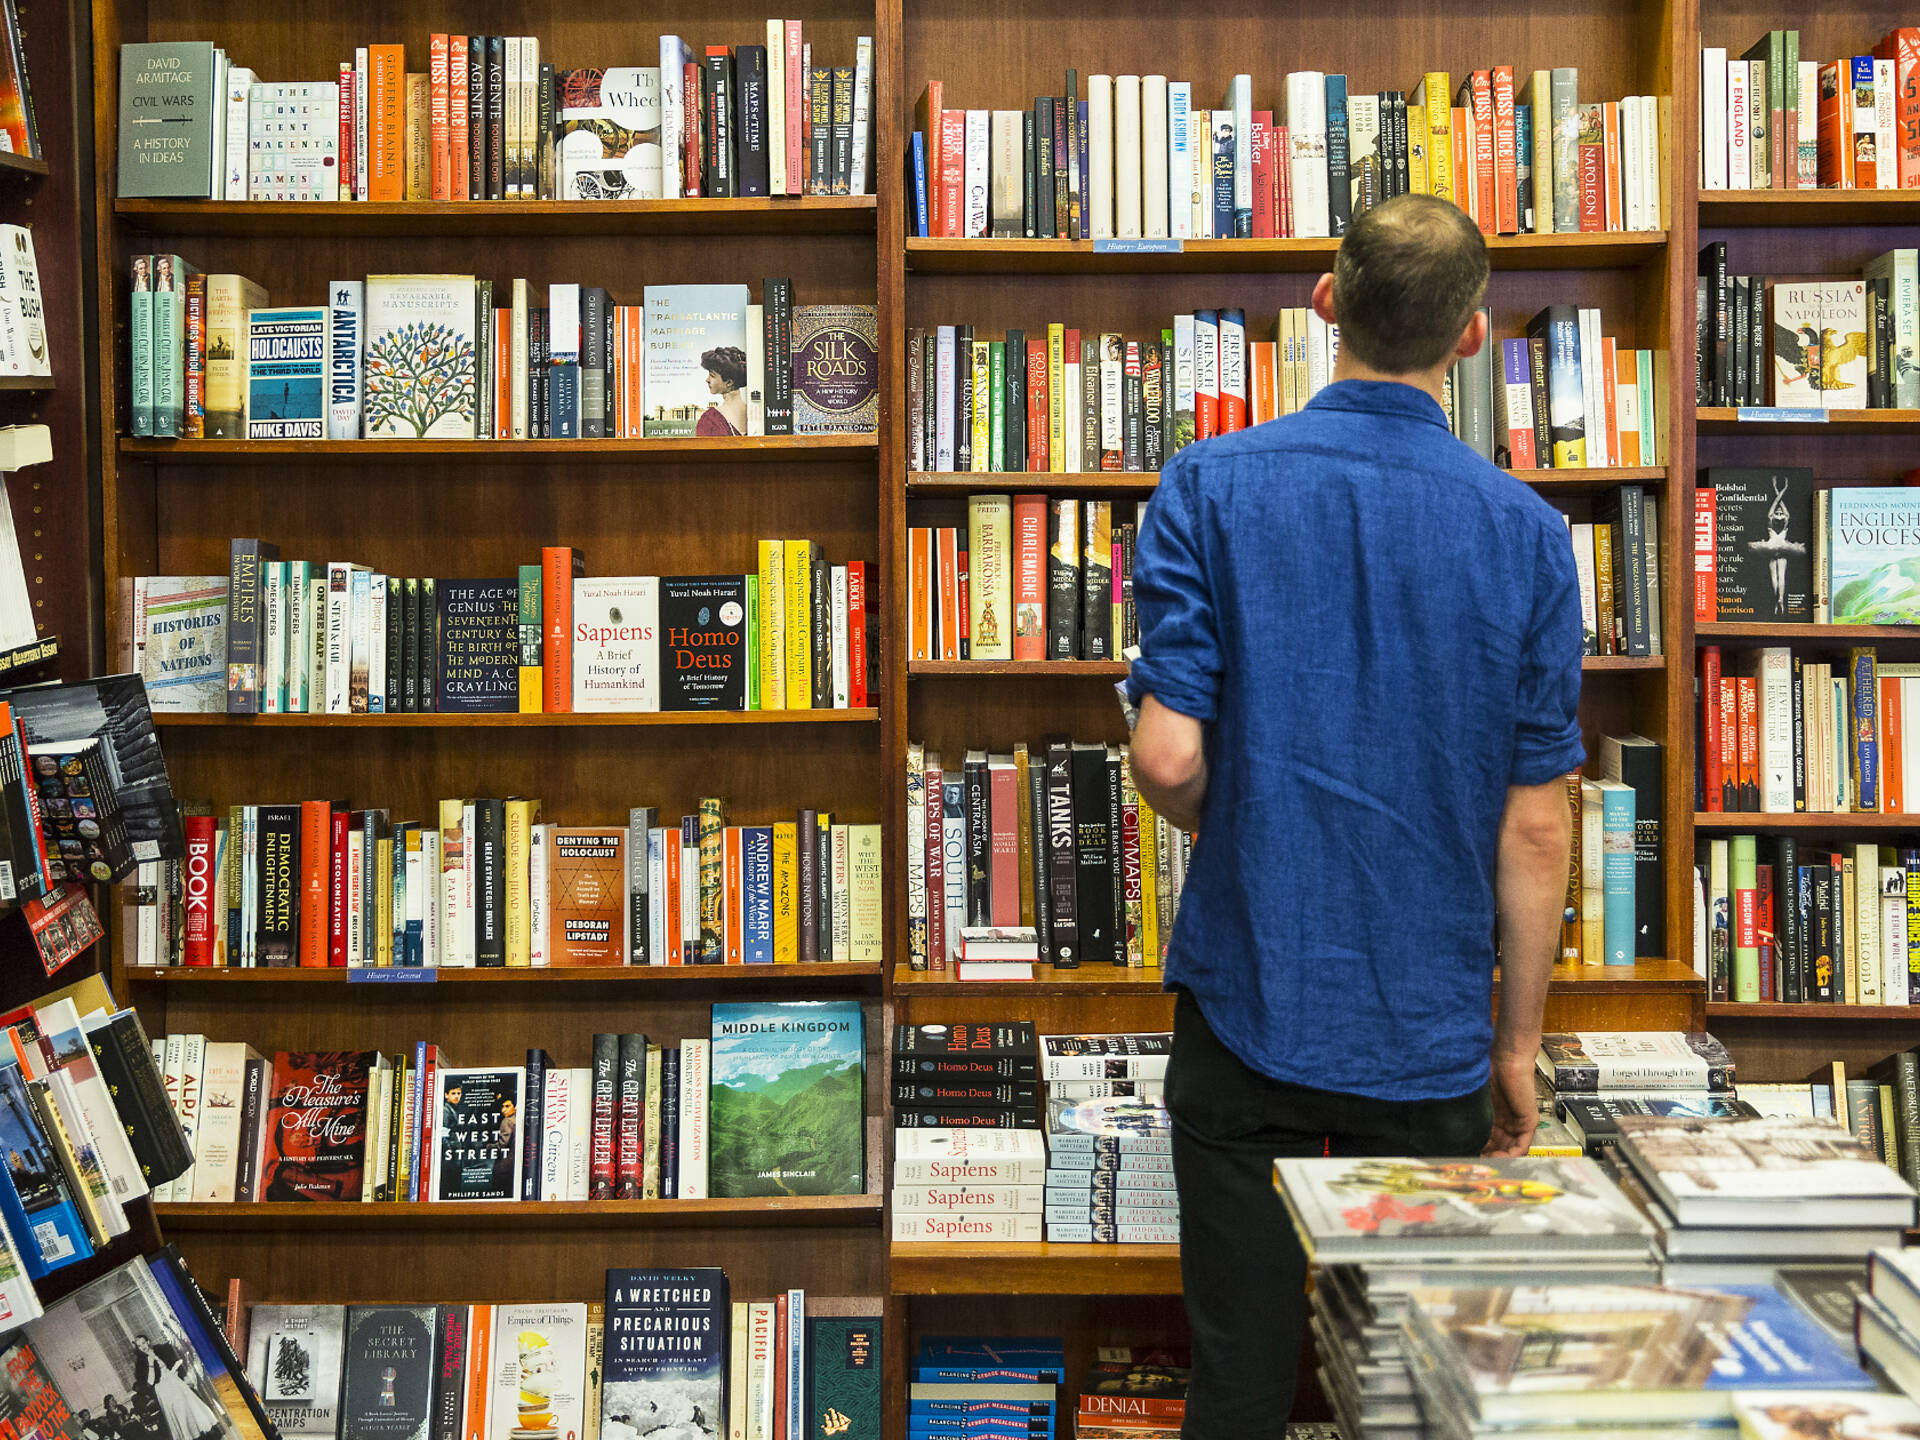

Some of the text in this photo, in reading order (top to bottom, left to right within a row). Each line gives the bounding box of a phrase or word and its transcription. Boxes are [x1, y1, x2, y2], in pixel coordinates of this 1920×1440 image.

[790, 31, 799, 56] MAPS
[147, 57, 180, 70] DAVID
[136, 71, 192, 83] ARMITAGE
[132, 95, 194, 108] CIVIL WARS
[471, 62, 482, 119] AGENTE
[489, 62, 501, 119] AGENTE
[386, 54, 396, 176] GEOFFREY BLAINEY
[1174, 93, 1187, 152] PADDY ASHDOWN
[1497, 84, 1514, 157] TOSS DICE
[1734, 87, 1744, 147] ENGLAND
[133, 137, 191, 149] A HISTORY
[1251, 122, 1263, 164] Barker
[139, 152, 184, 164] IN IDEAS
[1584, 148, 1596, 215] NAPOLEON
[971, 185, 984, 230] Civil War
[1788, 289, 1855, 304] RUSSIA
[20, 297, 41, 319] BUSH
[650, 312, 738, 321] TRANSATLANTIC
[1784, 309, 1858, 320] NAPOLEON
[251, 323, 322, 334] LATE VICTORIAN
[588, 296, 597, 365] ORIANA FALLACI
[829, 333, 845, 341] THE
[188, 298, 199, 415] DICTATORS WITHOUT BORDERS
[251, 337, 323, 360] HOLOCAUSTS
[331, 309, 356, 404] ANTARCTICA
[813, 341, 859, 361] SILK
[807, 360, 866, 381] ROADS
[1035, 352, 1046, 387] GOD'S
[1230, 334, 1240, 388] FRENCH
[1534, 343, 1545, 388] Lionheart
[1146, 369, 1160, 424] WATERLOO
[251, 421, 321, 438] MIKE DAVIS
[1715, 484, 1747, 492] Bolshoi
[1715, 494, 1767, 502] Confidential
[1840, 512, 1920, 527] ENGLISH
[1841, 528, 1920, 545] VOICES
[981, 524, 993, 597] BARBAROSSA
[1021, 517, 1038, 598] CHARLEMAGNE
[240, 553, 255, 623] EMPIRES
[850, 572, 860, 611] LABOUR
[1632, 557, 1640, 606] ANGLO-SAXON
[670, 588, 737, 599] Yuval Noah Harari
[292, 575, 300, 635] TIMEKEEPERS
[1716, 606, 1754, 614] Morrison
[153, 613, 221, 634] HISTORIES
[316, 586, 325, 658] ON THE MAP
[447, 614, 519, 626] SEVENTEENTH
[795, 550, 808, 701] Shakespeare and Company Paris
[1634, 607, 1642, 633] WORLD
[179, 636, 196, 650] OF
[576, 624, 653, 648] Sapiens
[669, 628, 740, 647] Homo
[160, 654, 212, 673] NATIONS
[596, 650, 632, 661] A Brief
[675, 650, 732, 669] Deus
[587, 664, 641, 677] History of
[446, 681, 517, 692] GRAYLING
[584, 678, 645, 690] Humankind
[971, 784, 982, 857] CENTRAL ASIA
[1050, 783, 1072, 848] TANKS
[927, 778, 940, 877] MAPS OF WAR
[557, 836, 619, 846] DENYING THE
[561, 848, 615, 857] HOLOCAUST
[835, 830, 845, 884] MONSTERS
[188, 843, 208, 910] BOOK
[945, 827, 964, 911] SOUTH
[265, 832, 276, 932] ENLIGHTENMENT
[277, 833, 291, 932] DEMOCRATIC
[756, 832, 770, 940] ANDREW MARR
[802, 851, 812, 927] HORSE NATIONS
[333, 852, 341, 936] DECOLONIZATION
[1819, 880, 1829, 910] Madrid
[1743, 891, 1752, 924] MOSCOW
[565, 921, 609, 929] DEBORAH
[567, 932, 608, 941] LIPSTADT
[366, 971, 389, 980] History
[397, 971, 421, 979] General
[722, 1022, 850, 1034] MIDDLE KINGDOM
[937, 1062, 993, 1072] Homo Deus
[1611, 1068, 1698, 1080] Forged Through Fire
[313, 1073, 343, 1095] The
[181, 1074, 197, 1119] ALPS
[282, 1086, 361, 1109] Pleasure's
[458, 1112, 500, 1125] EAST
[620, 1059, 639, 1165] The GREAT LEVELER
[455, 1130, 500, 1143] WEST
[444, 1148, 510, 1160] STREET
[782, 1170, 816, 1178] SINCLAIR
[930, 1162, 998, 1184] Sapiens
[927, 1189, 995, 1210] Sapiens
[925, 1217, 993, 1239] Sapiens
[615, 1288, 711, 1302] A WRETCHED
[380, 1325, 405, 1335] THE
[613, 1317, 710, 1331] PRECARIOUS
[754, 1310, 768, 1360] PACIFIC
[368, 1337, 416, 1347] SECRET
[620, 1336, 702, 1351] SITUATION
[6, 1344, 37, 1380] FROM
[364, 1349, 417, 1360] LIBRARY
[14, 1380, 60, 1434] PADDOCK
[1088, 1397, 1150, 1416] DENIAL
